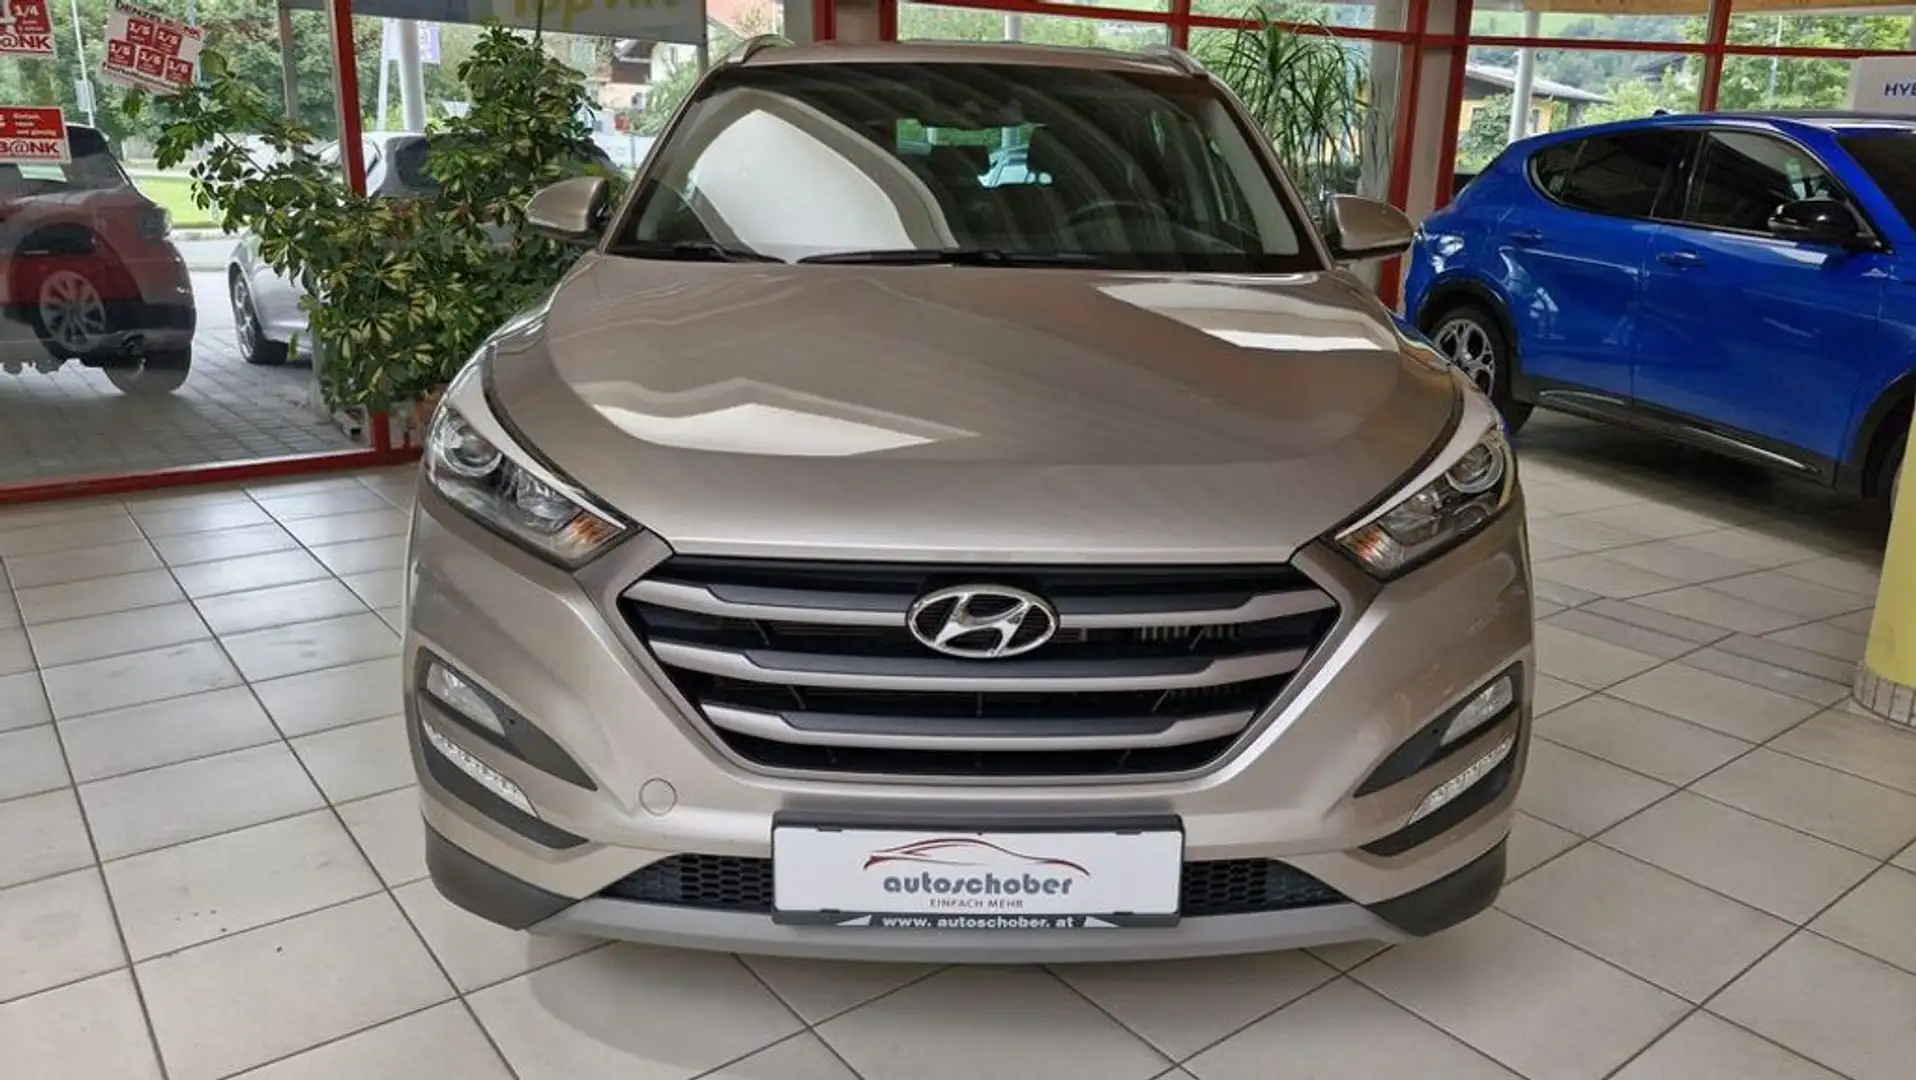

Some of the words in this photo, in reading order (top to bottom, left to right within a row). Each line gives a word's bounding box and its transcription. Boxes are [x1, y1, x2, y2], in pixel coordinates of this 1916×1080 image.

[15, 4, 40, 18] 1/4
[883, 872, 1073, 895] autoschober
[930, 899, 983, 908] EINFACH
[988, 899, 1023, 908] MEHR
